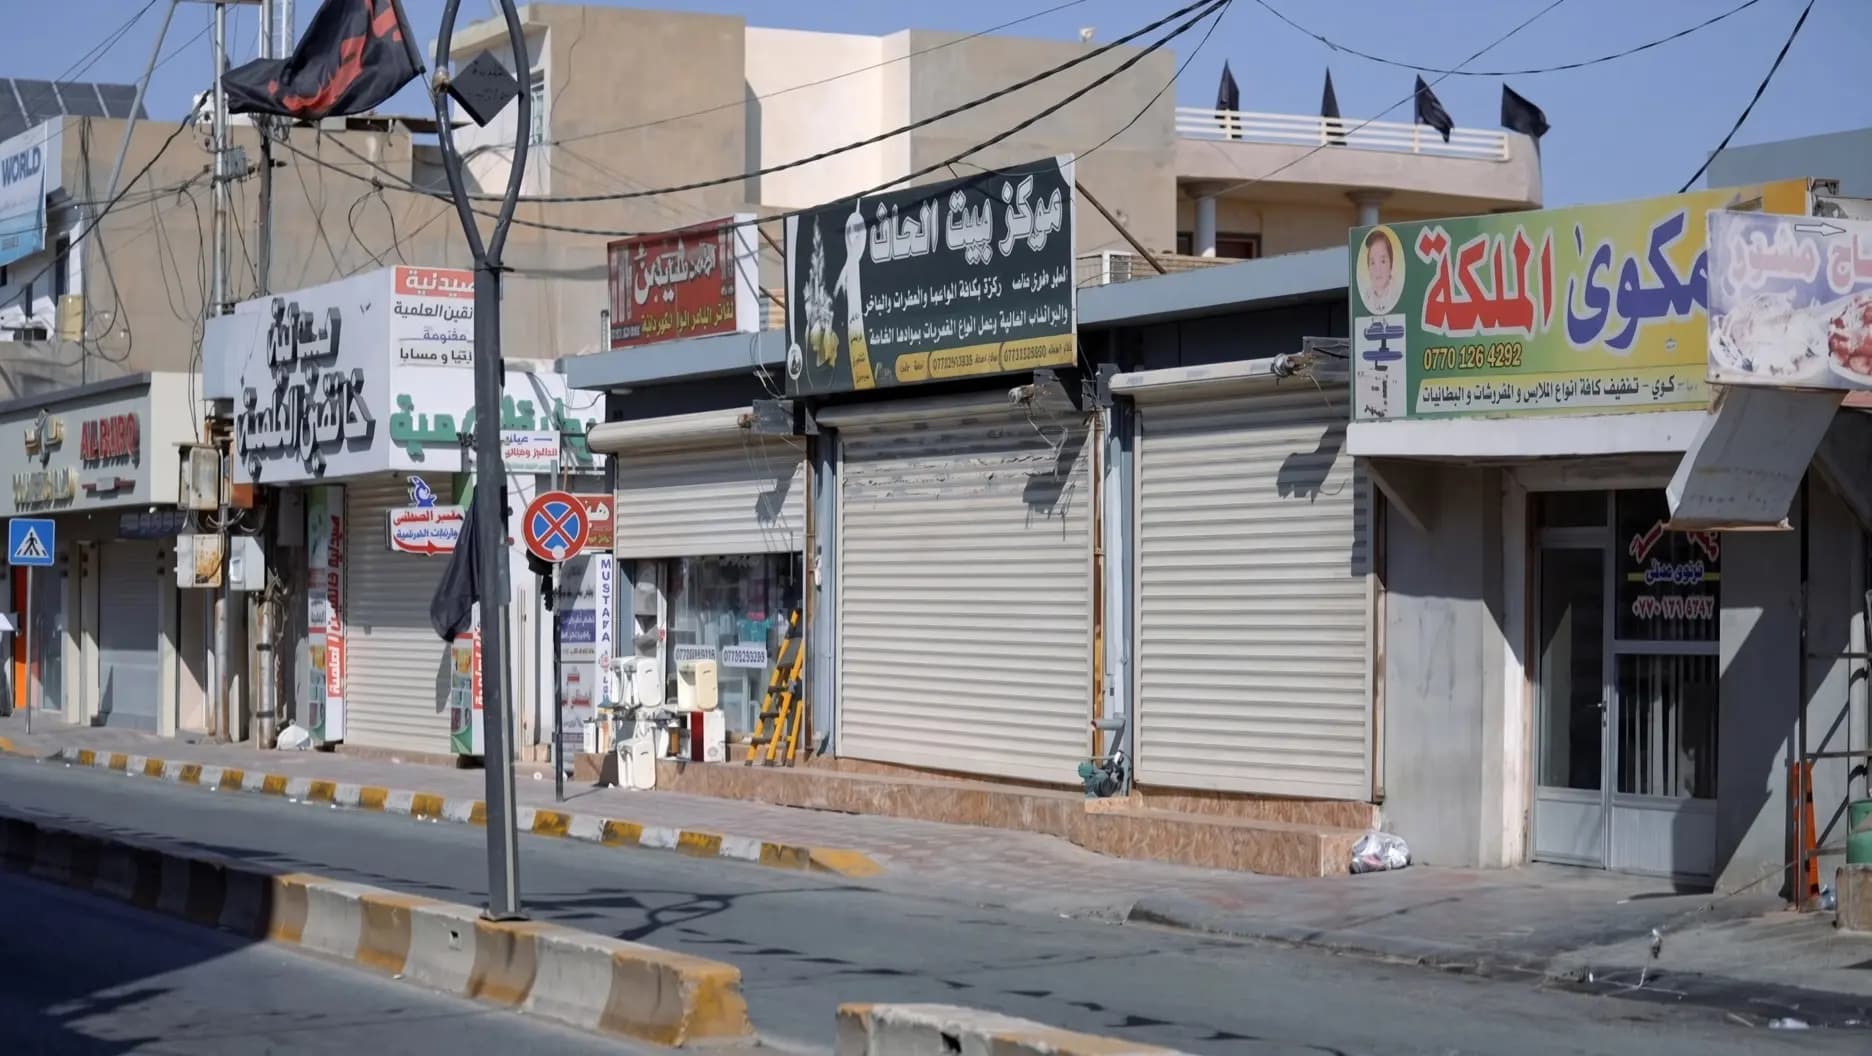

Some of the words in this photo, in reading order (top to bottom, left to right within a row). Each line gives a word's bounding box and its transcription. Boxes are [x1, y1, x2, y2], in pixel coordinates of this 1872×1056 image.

[2, 146, 41, 188] WORLD
[1416, 228, 1553, 335] الملكة
[394, 301, 443, 318] العلمية
[1423, 346, 1456, 371] 0770
[1458, 345, 1485, 370] 126
[1487, 342, 1522, 368] 4292
[1523, 381, 1553, 404] الملابس
[1555, 379, 1578, 403] انواع
[1580, 378, 1601, 396] كافة
